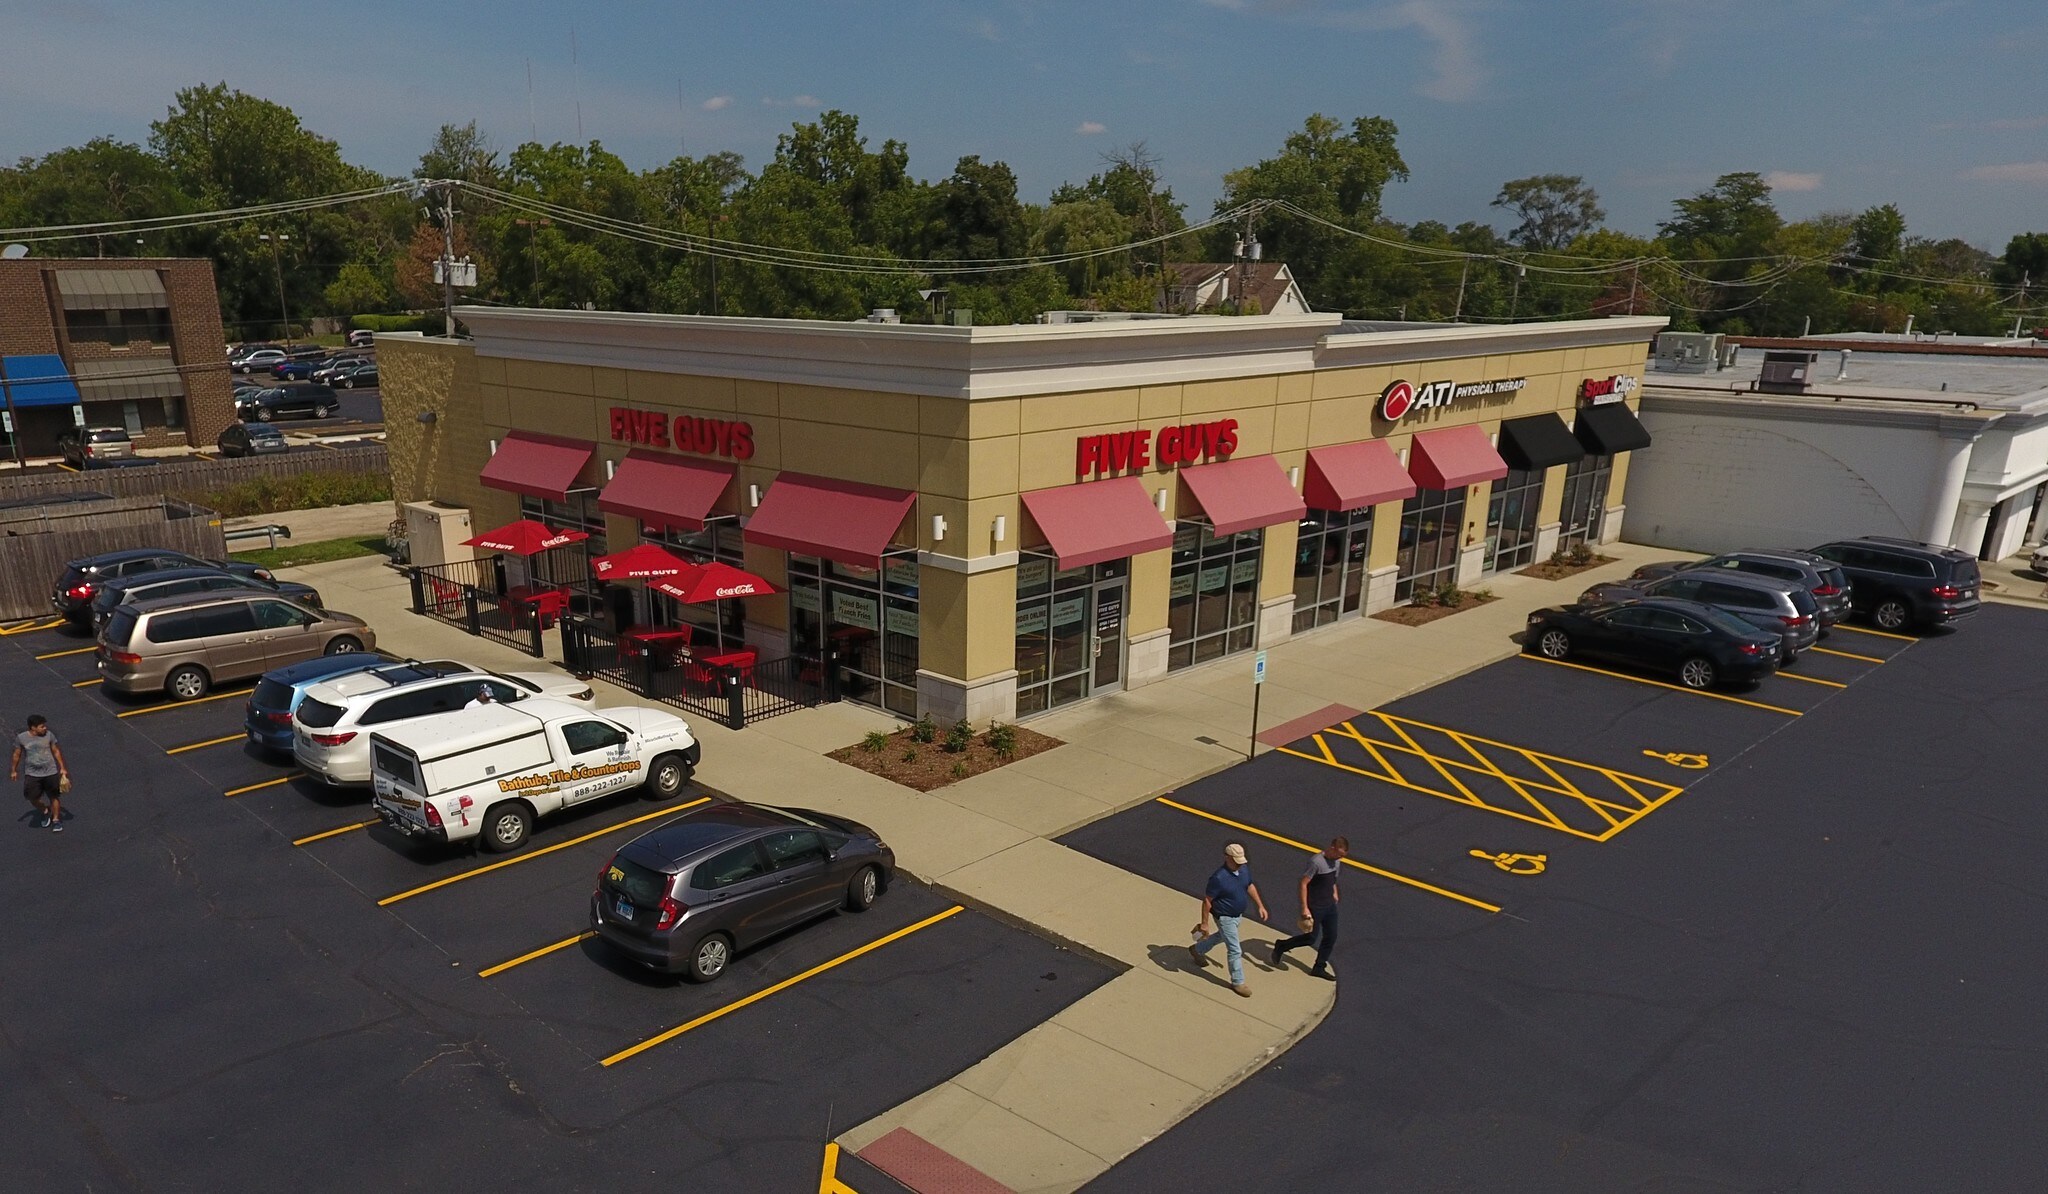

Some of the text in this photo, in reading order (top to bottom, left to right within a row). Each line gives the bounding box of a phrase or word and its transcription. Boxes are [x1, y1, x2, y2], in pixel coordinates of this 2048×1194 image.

[1415, 378, 1527, 409] ATI PHYSICAL THERAPY
[609, 407, 755, 460] FIVE GUYS
[1076, 418, 1239, 476] FIVE GUYS
[716, 584, 755, 597] Coca-Cola
[839, 598, 869, 612] Voted Best
[498, 773, 552, 793] Bathtubs,
[550, 768, 571, 784] Tile
[571, 768, 581, 781] &
[580, 760, 642, 779] Countertops
[574, 774, 628, 798] 888-222-1227
